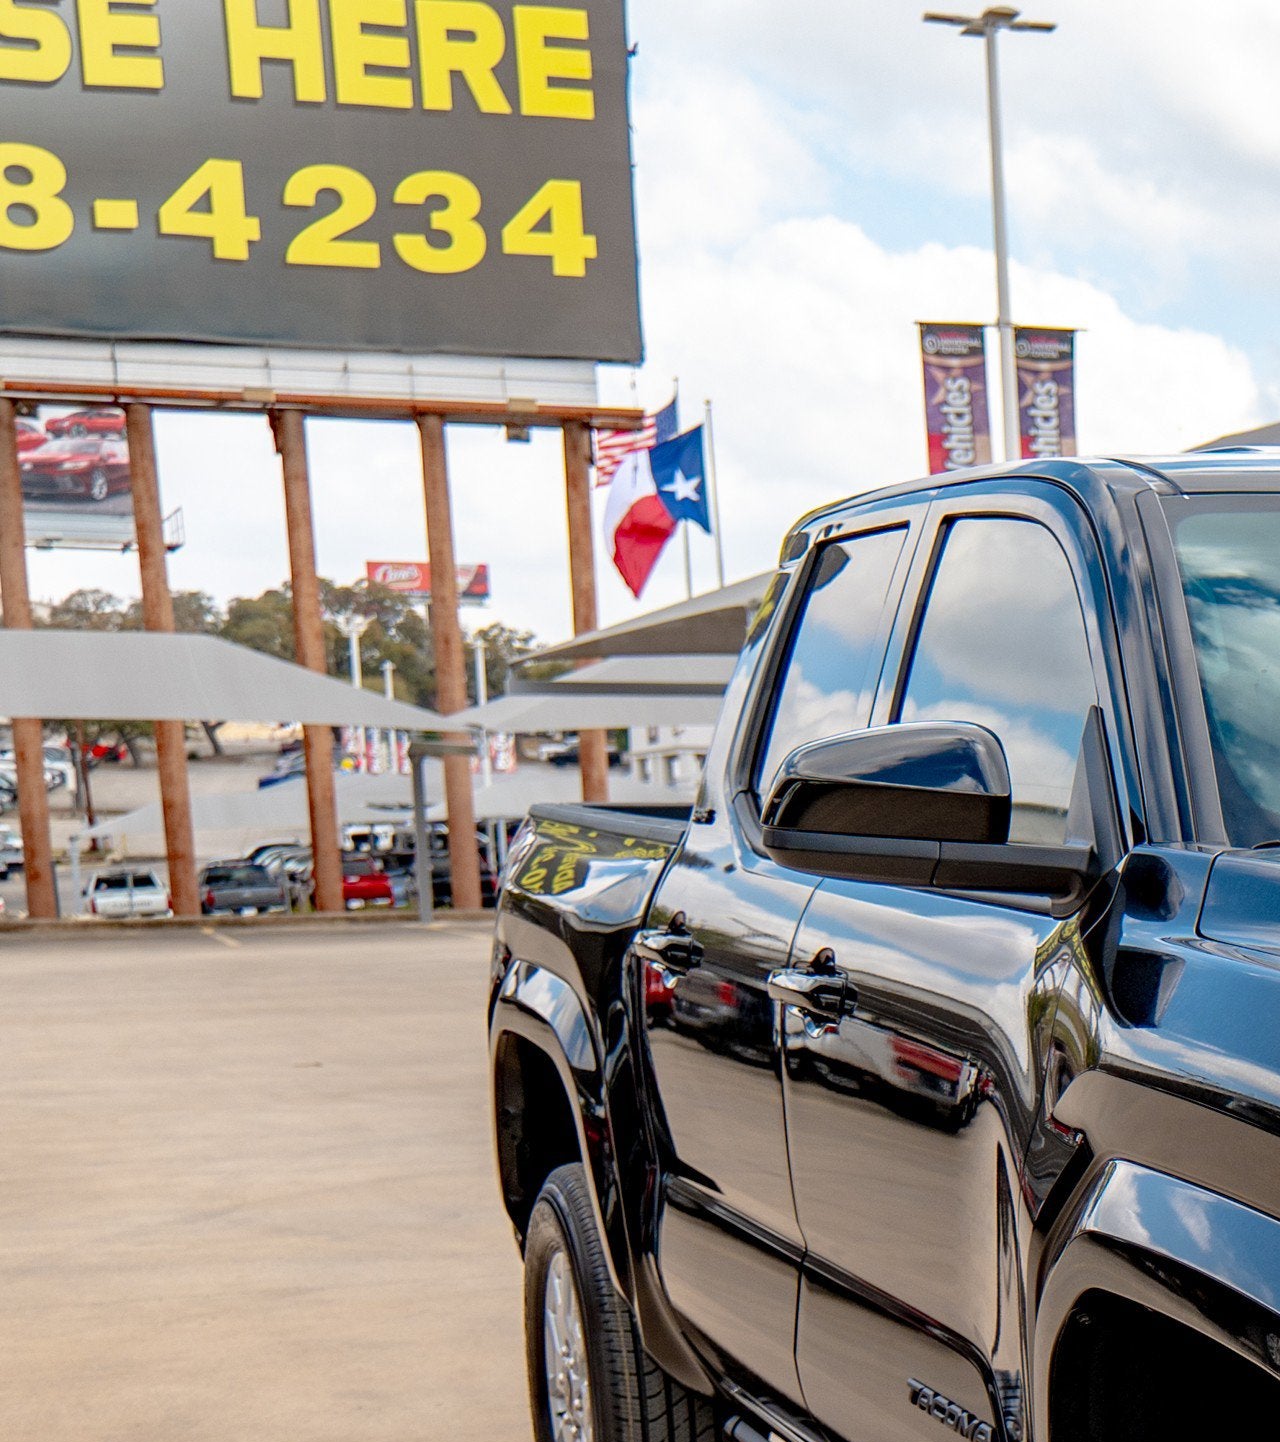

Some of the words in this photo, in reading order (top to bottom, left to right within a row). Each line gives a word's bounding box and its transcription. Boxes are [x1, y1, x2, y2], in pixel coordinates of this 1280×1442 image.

[0, 0, 165, 88] SE
[224, 0, 595, 120] HERE
[0, 142, 598, 278] 8-4234
[1027, 379, 1062, 457] hicles
